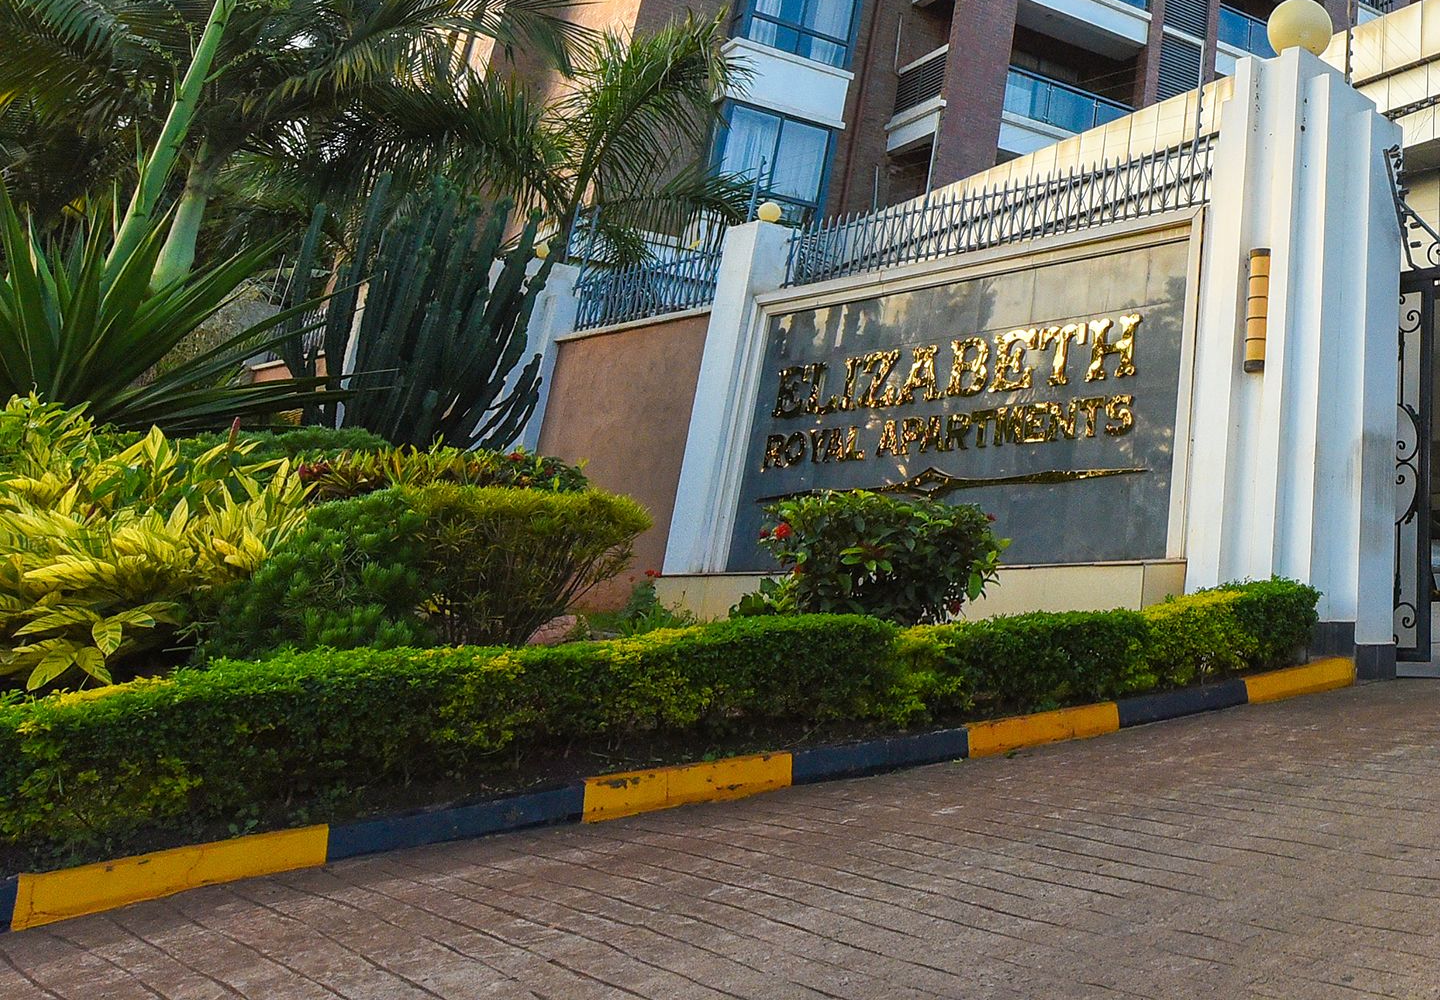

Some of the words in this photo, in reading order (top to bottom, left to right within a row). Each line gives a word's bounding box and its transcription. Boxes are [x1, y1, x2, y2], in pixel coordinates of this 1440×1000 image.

[771, 313, 1143, 418] ELIZABETH
[760, 425, 866, 472] ROYAL
[876, 394, 1135, 457] APARTMENTS
